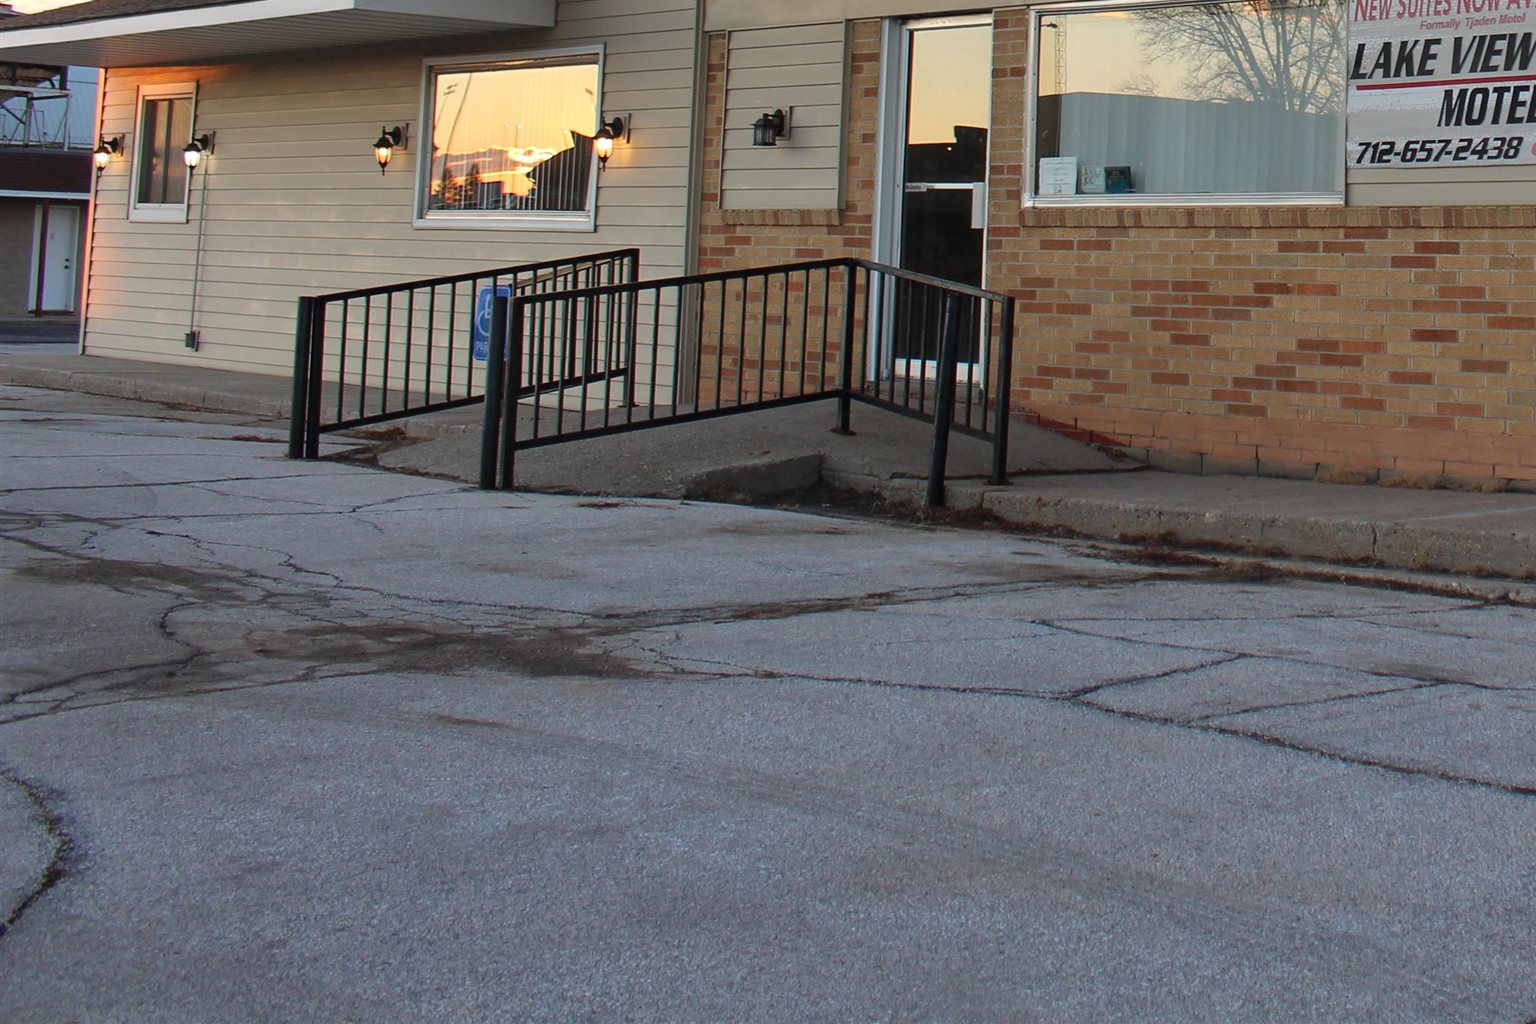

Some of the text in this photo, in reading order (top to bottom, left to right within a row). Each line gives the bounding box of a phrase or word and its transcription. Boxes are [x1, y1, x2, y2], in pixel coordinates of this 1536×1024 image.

[1420, 13, 1526, 31] Formally Tjaden Motel
[1350, 38, 1442, 80] LAKE
[1356, 136, 1524, 164] 712-657-2438
